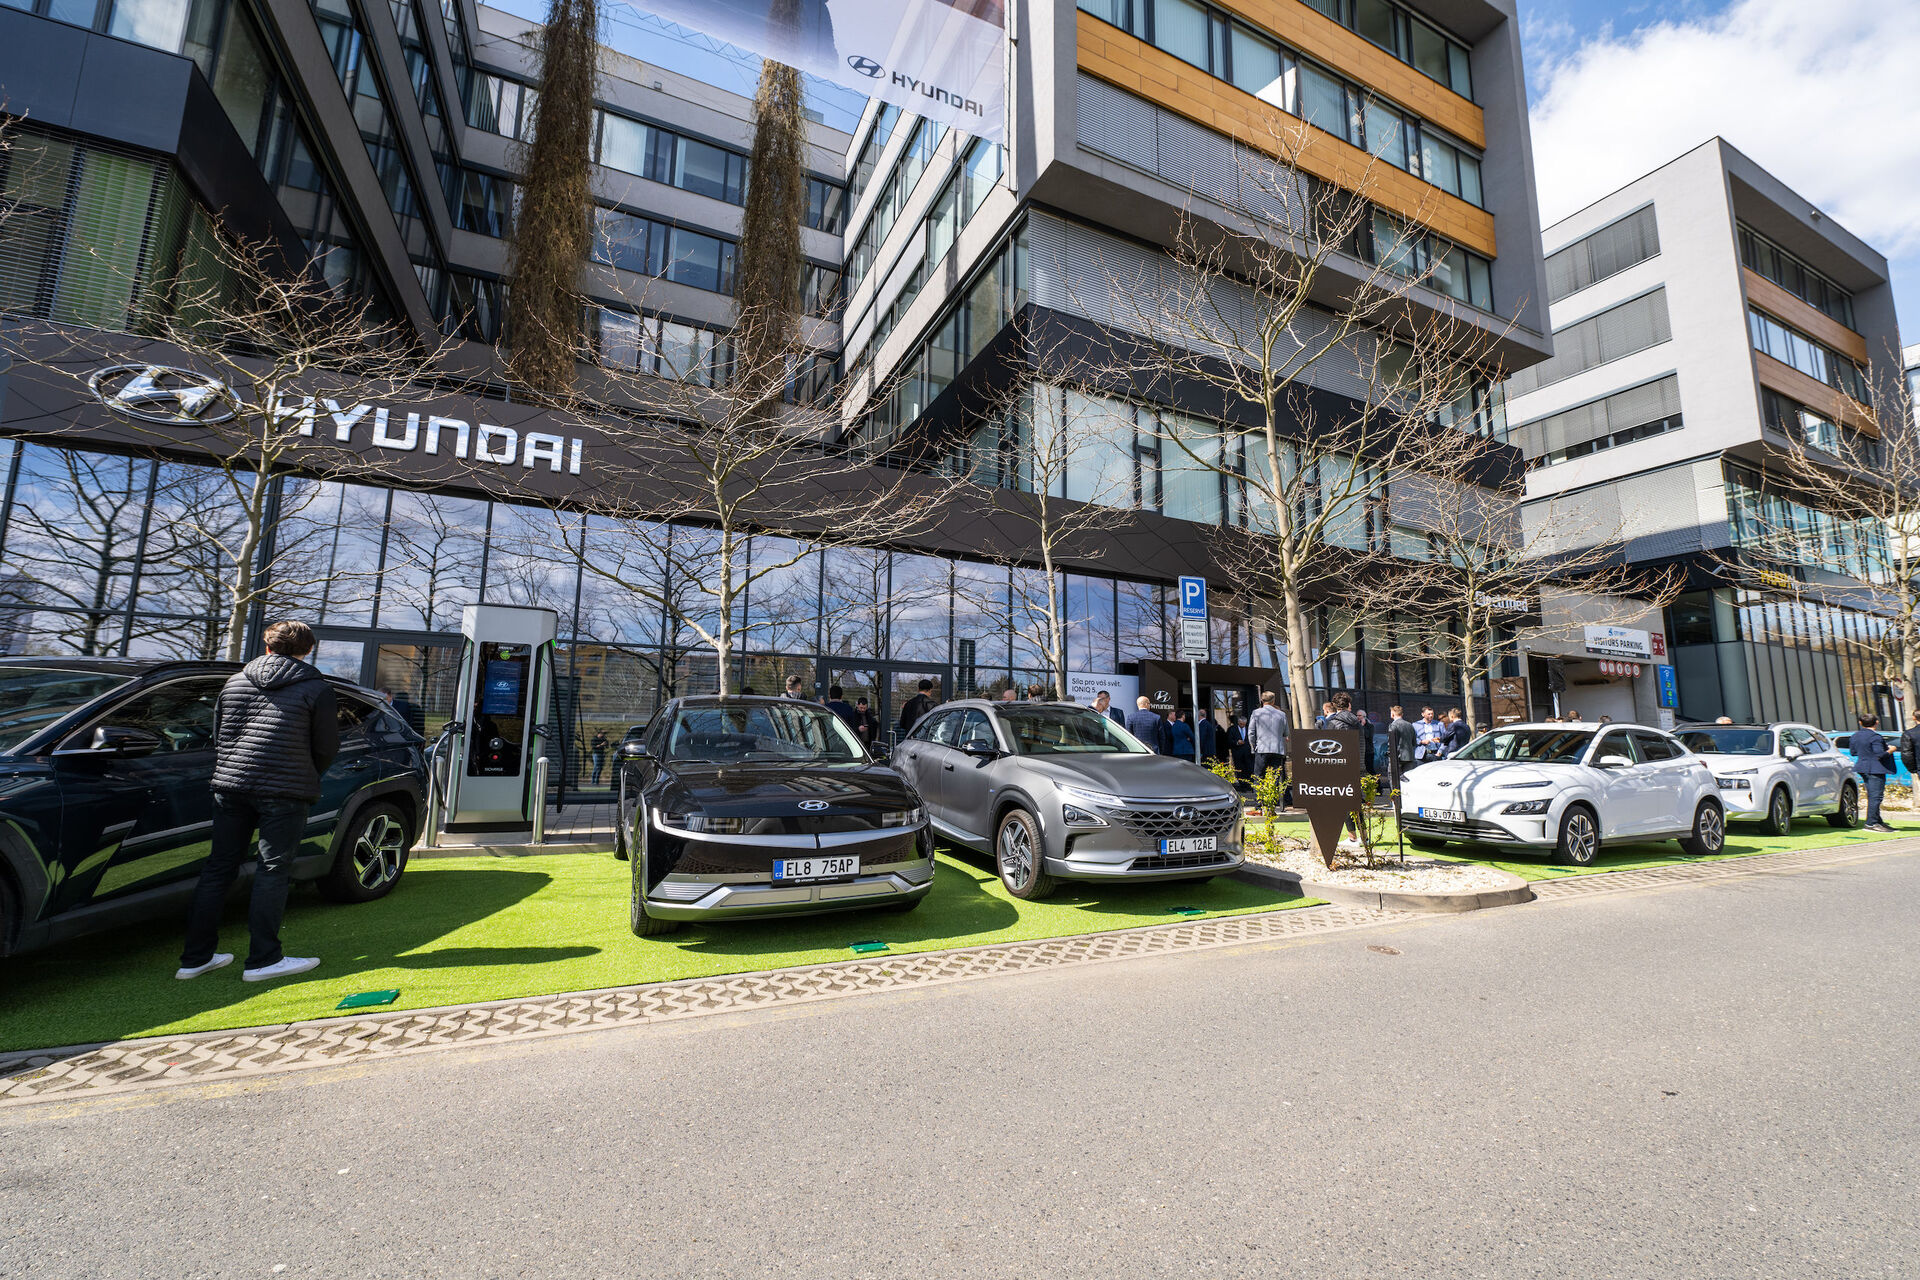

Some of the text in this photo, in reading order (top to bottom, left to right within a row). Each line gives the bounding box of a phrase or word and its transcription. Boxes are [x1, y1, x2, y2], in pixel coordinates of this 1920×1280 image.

[892, 71, 983, 117] HYUNDAI
[270, 391, 582, 475] HYUNDAI
[1185, 582, 1200, 605] P
[1620, 640, 1643, 651] PARKING
[1071, 685, 1091, 693] IONIQ
[1304, 757, 1347, 765] HYUNDAI
[1299, 783, 1354, 797] Reservé
[1168, 840, 1185, 853] EL4
[1192, 838, 1213, 851] 12AE
[786, 861, 811, 876] EL8
[821, 858, 853, 874] 75AP
